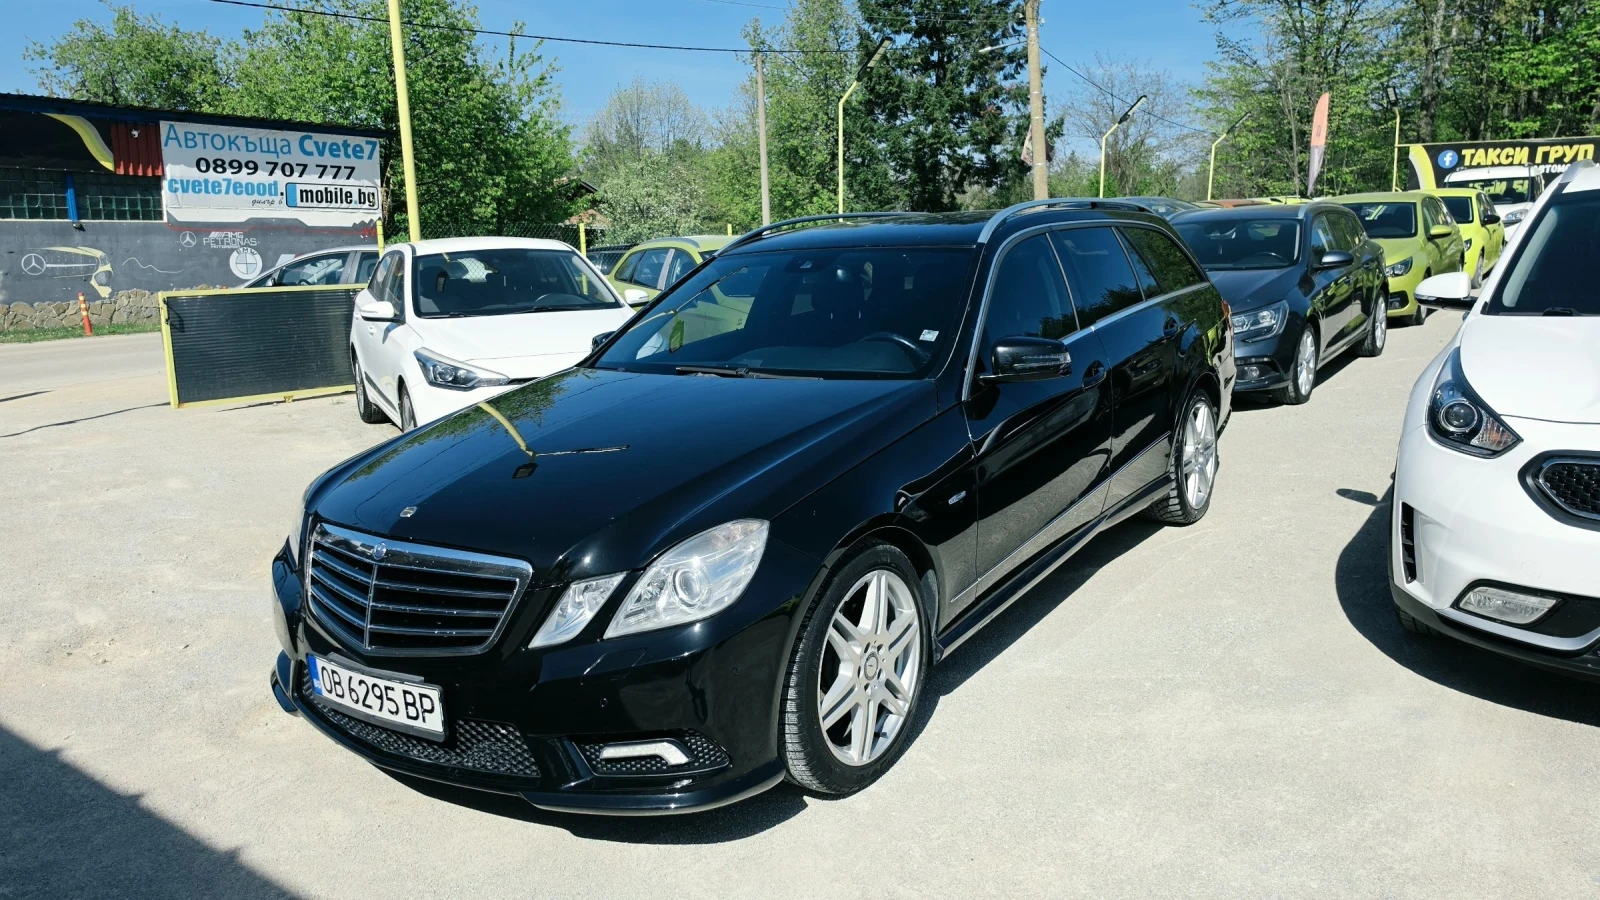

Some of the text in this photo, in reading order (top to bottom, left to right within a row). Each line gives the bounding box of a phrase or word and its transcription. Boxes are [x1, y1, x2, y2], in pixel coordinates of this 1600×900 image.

[163, 123, 378, 160] Автокъща Cvete7
[1461, 144, 1595, 166] ТАКСИ ГРУП
[195, 157, 356, 180] 0899 707 777
[299, 186, 376, 207] mobile.bg
[202, 237, 258, 247] PETRONAS
[235, 247, 258, 256] BMW
[321, 665, 435, 723] OB 6295 BP
